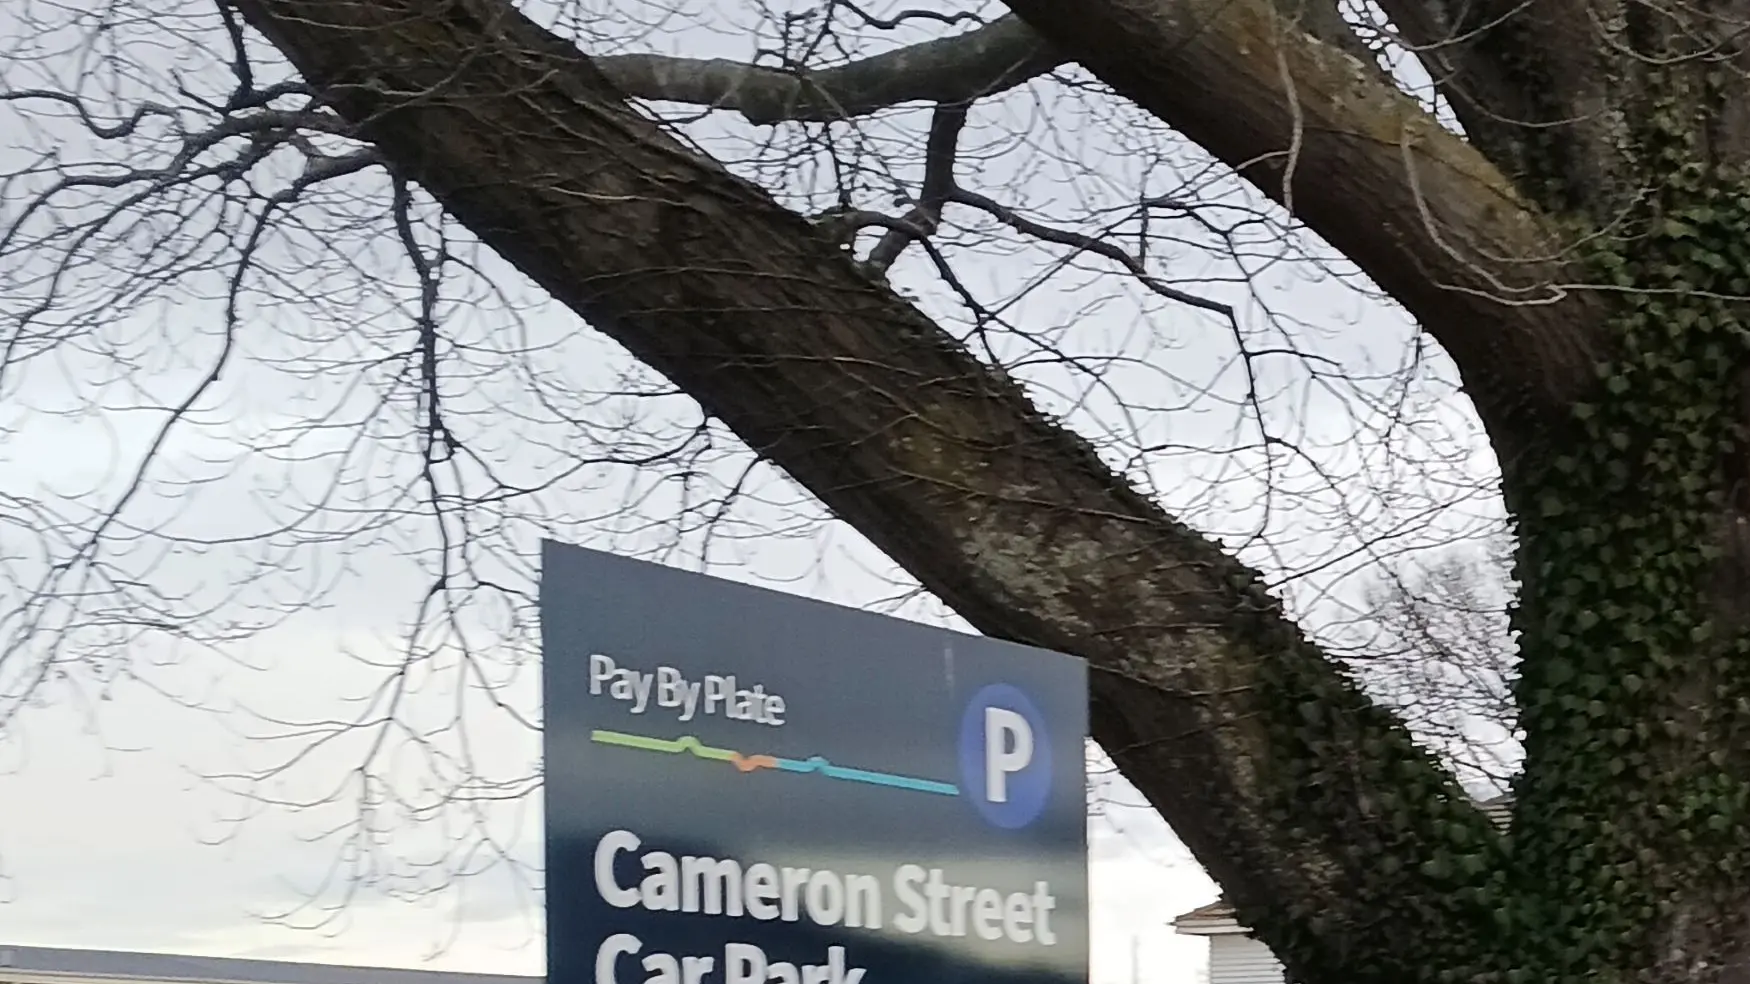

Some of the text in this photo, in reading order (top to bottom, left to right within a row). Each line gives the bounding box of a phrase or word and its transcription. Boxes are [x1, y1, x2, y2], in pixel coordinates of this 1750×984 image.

[590, 654, 786, 726] Pay By Plate
[985, 706, 1033, 803] P
[594, 830, 1057, 946] Cameron Street
